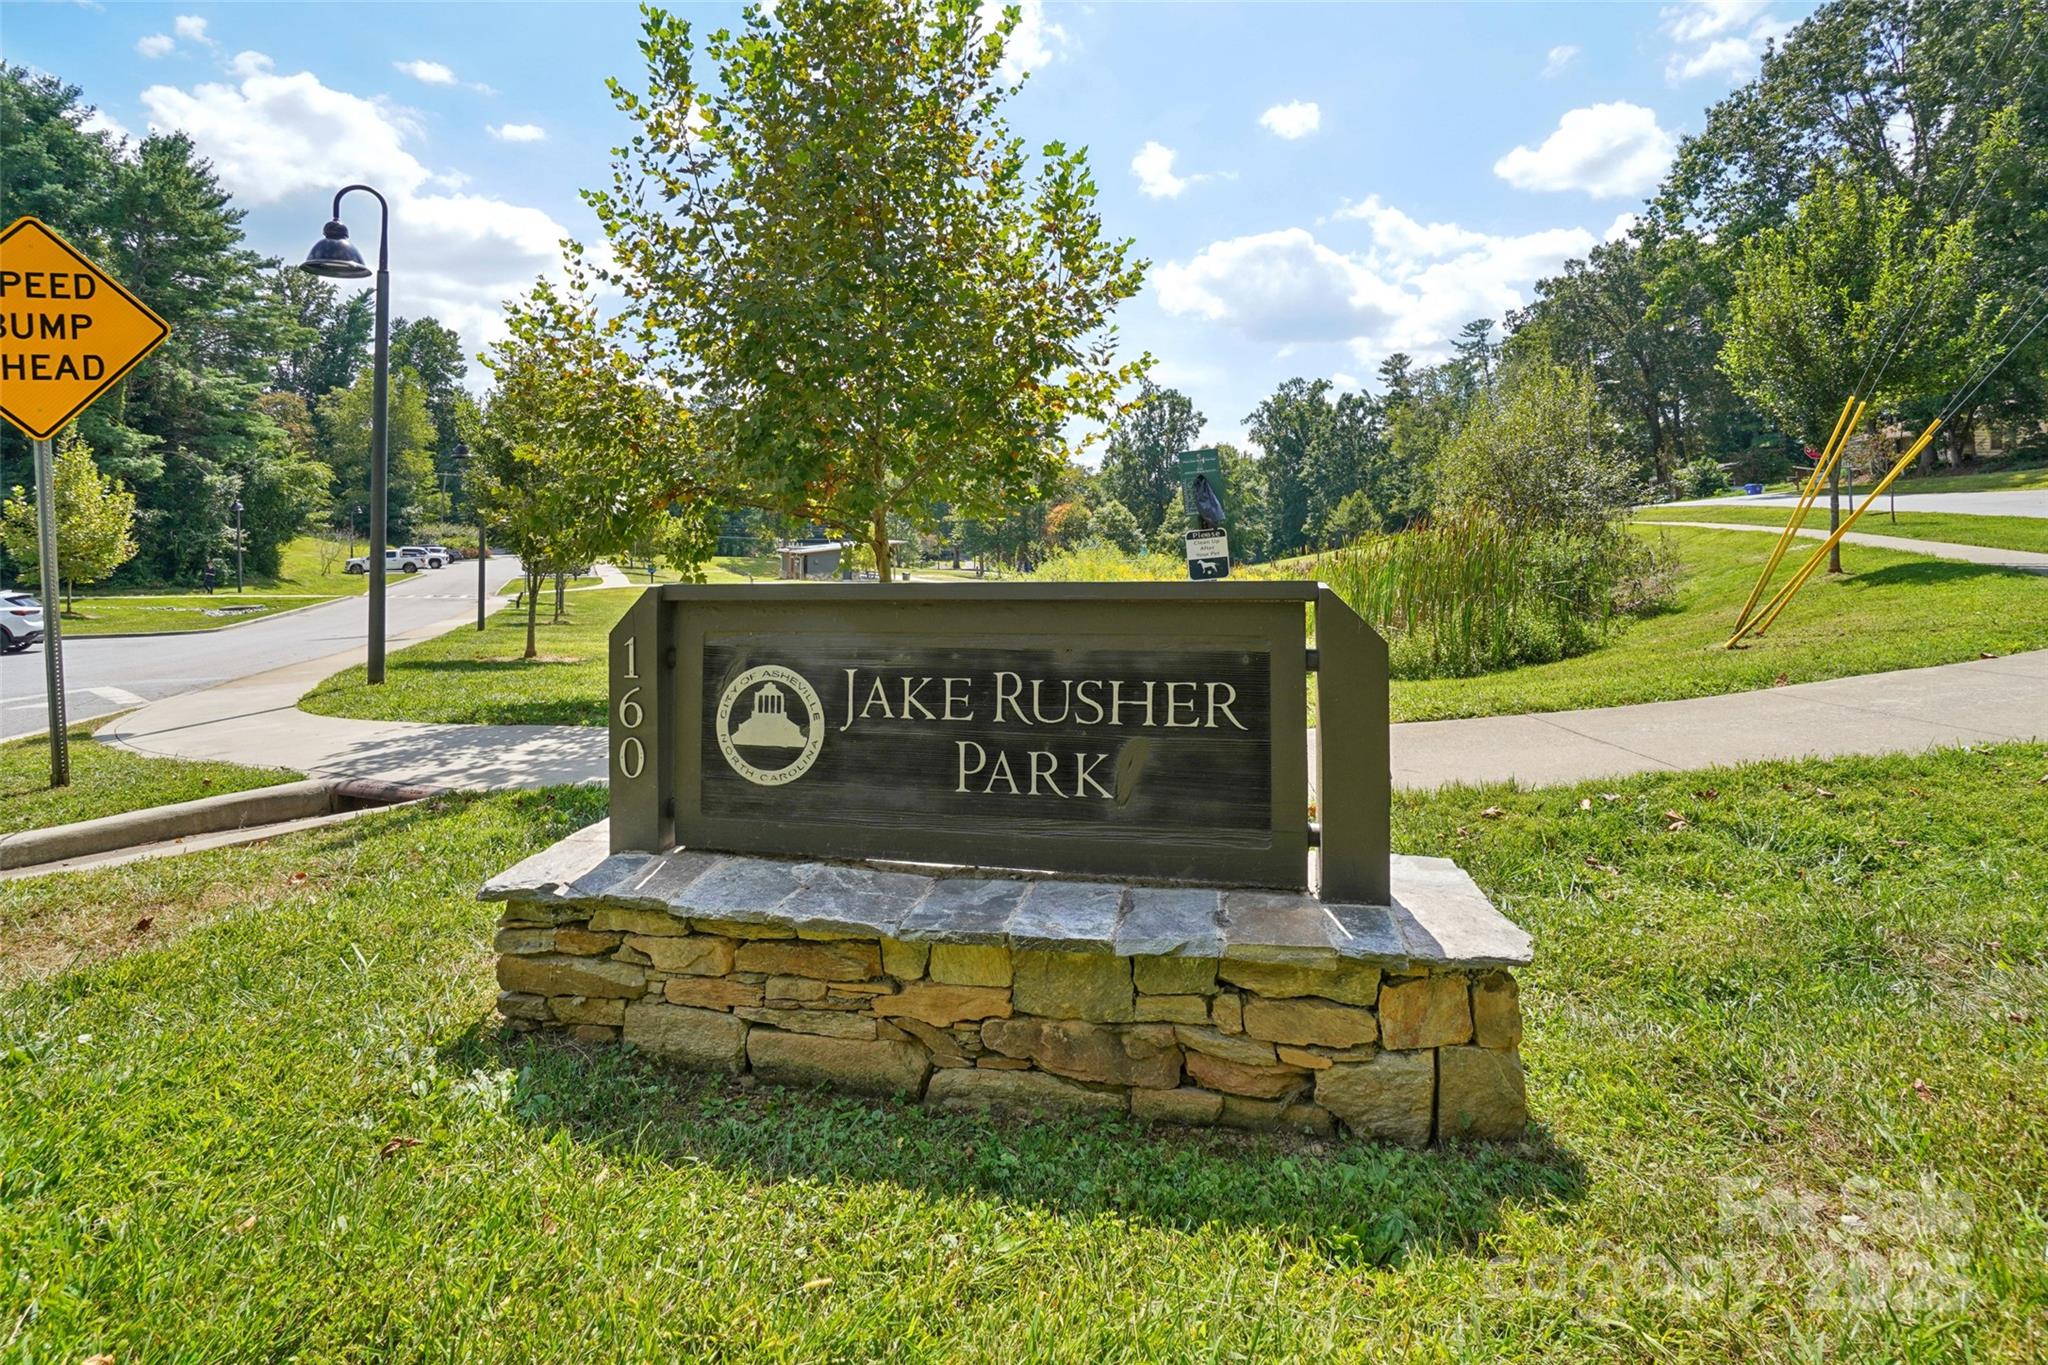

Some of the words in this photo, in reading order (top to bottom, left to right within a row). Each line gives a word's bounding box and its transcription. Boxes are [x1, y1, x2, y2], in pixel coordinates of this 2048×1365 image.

[1192, 531, 1221, 539] Please
[720, 685, 738, 720] CITY
[740, 672, 757, 685] OF
[762, 670, 821, 721] ASHEVILLE
[840, 668, 974, 732] JAKE
[992, 671, 1249, 731] RUSHER
[720, 733, 755, 778] NORTH
[759, 740, 819, 782] CAROLINA
[954, 740, 1114, 799] PARK
